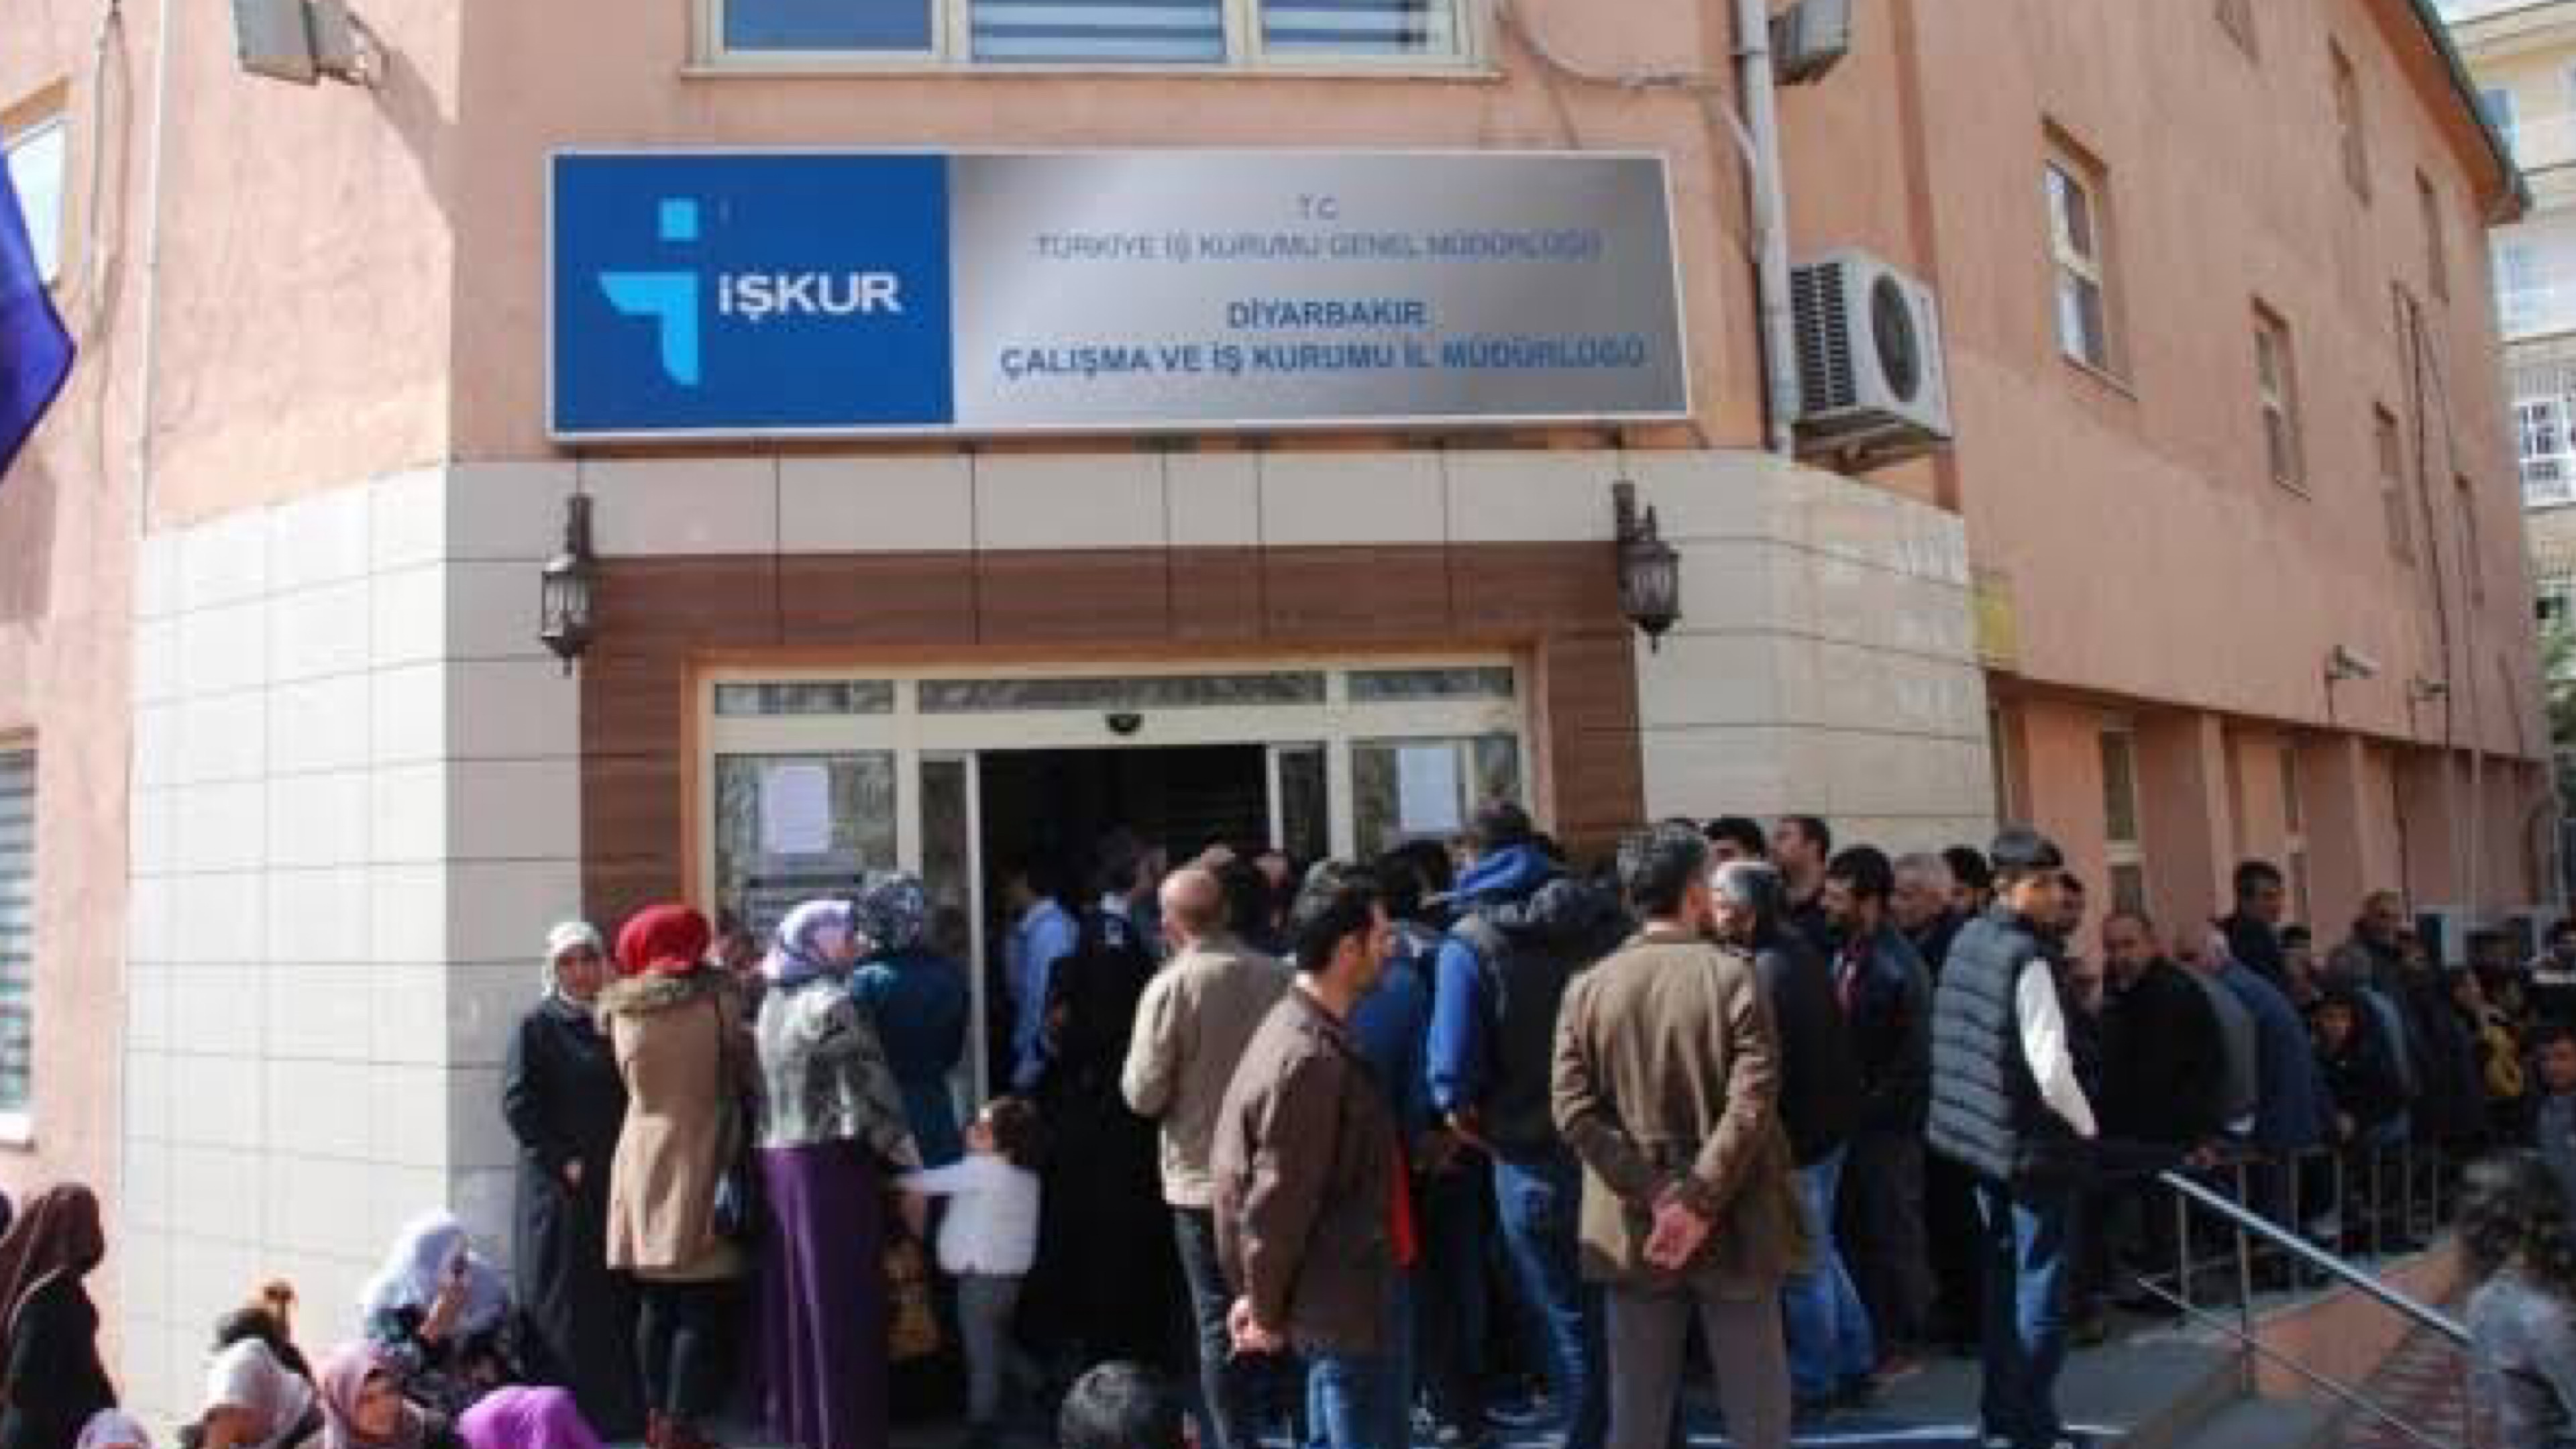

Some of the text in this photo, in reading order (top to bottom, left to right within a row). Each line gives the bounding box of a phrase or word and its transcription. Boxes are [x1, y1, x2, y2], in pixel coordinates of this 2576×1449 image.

[1228, 297, 1427, 329] DİYARBAKIR
[1000, 347, 1150, 378] ÇALIŞMA
[1161, 346, 1201, 372] VE
[1213, 341, 1242, 376] İŞ
[1253, 344, 1395, 369] KURUMU
